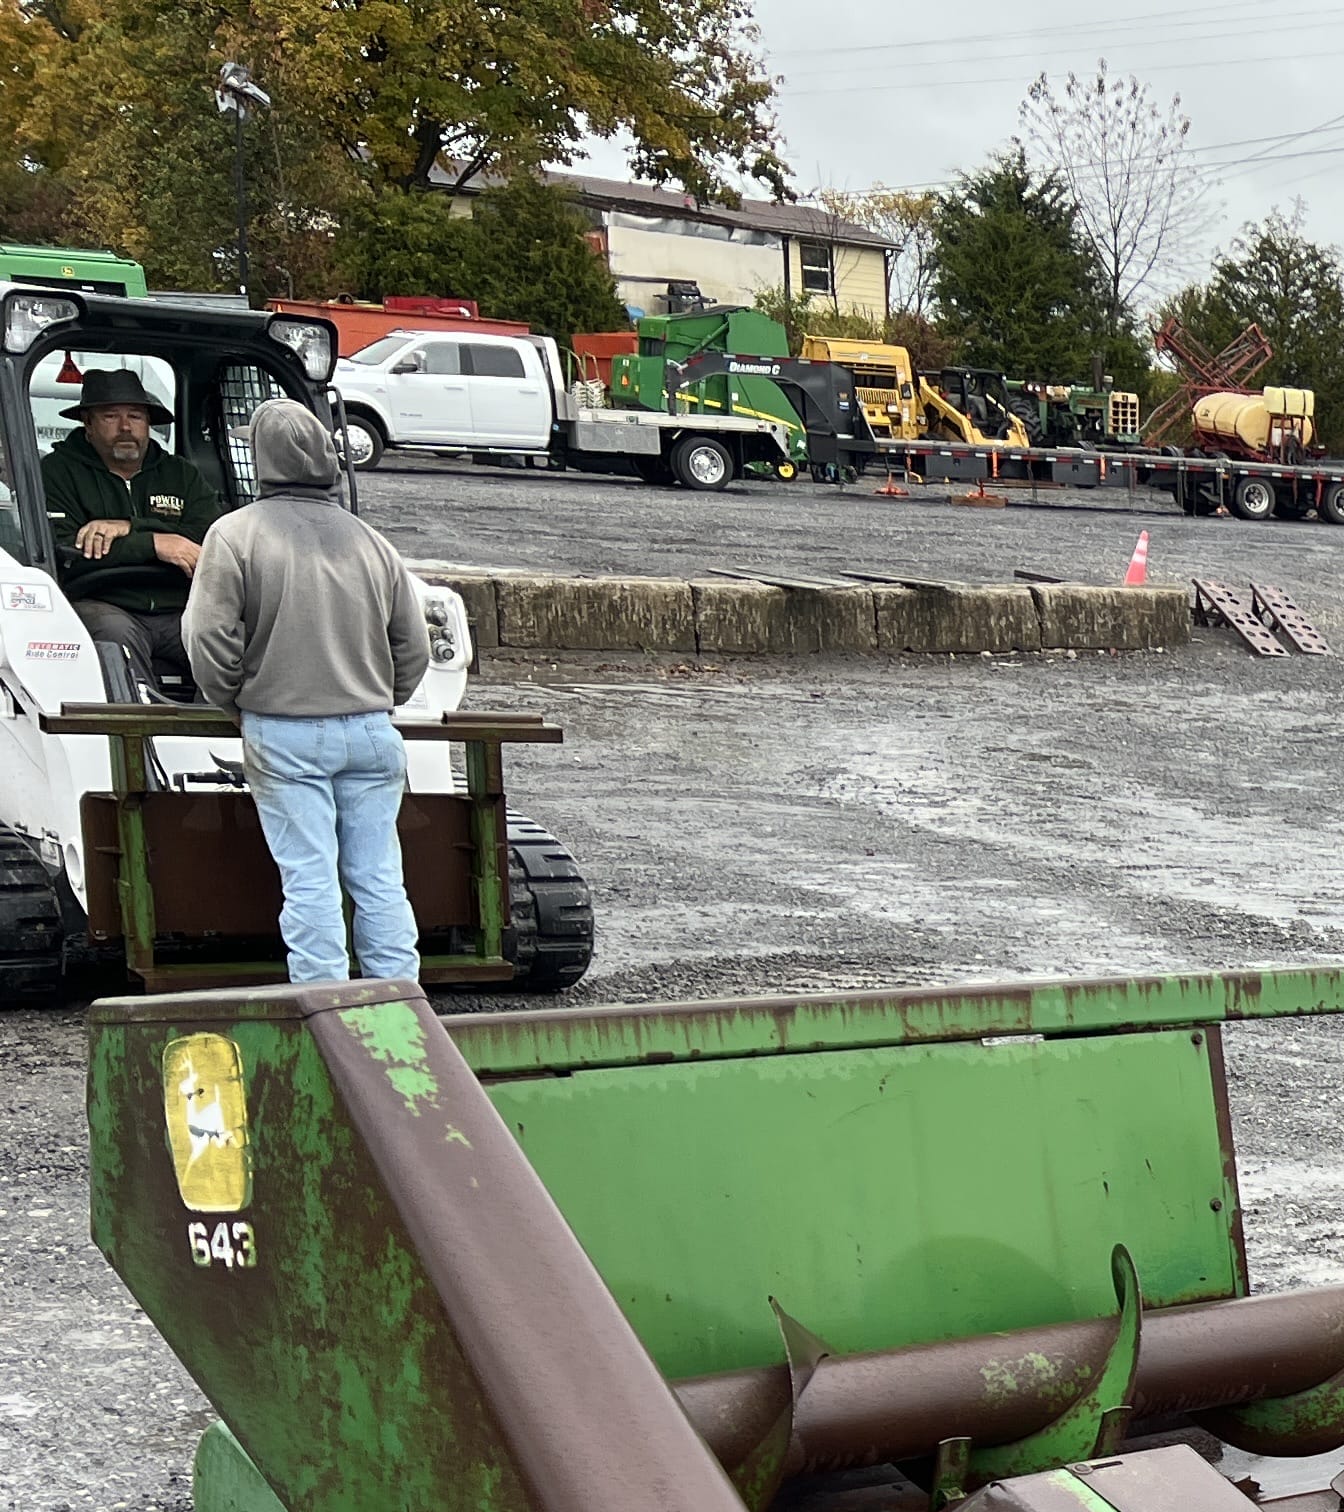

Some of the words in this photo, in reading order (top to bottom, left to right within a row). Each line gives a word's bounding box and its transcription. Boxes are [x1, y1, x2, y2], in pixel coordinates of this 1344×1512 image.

[729, 361, 771, 375] DIAMOND
[771, 364, 781, 375] C
[188, 1222, 257, 1269] 643
